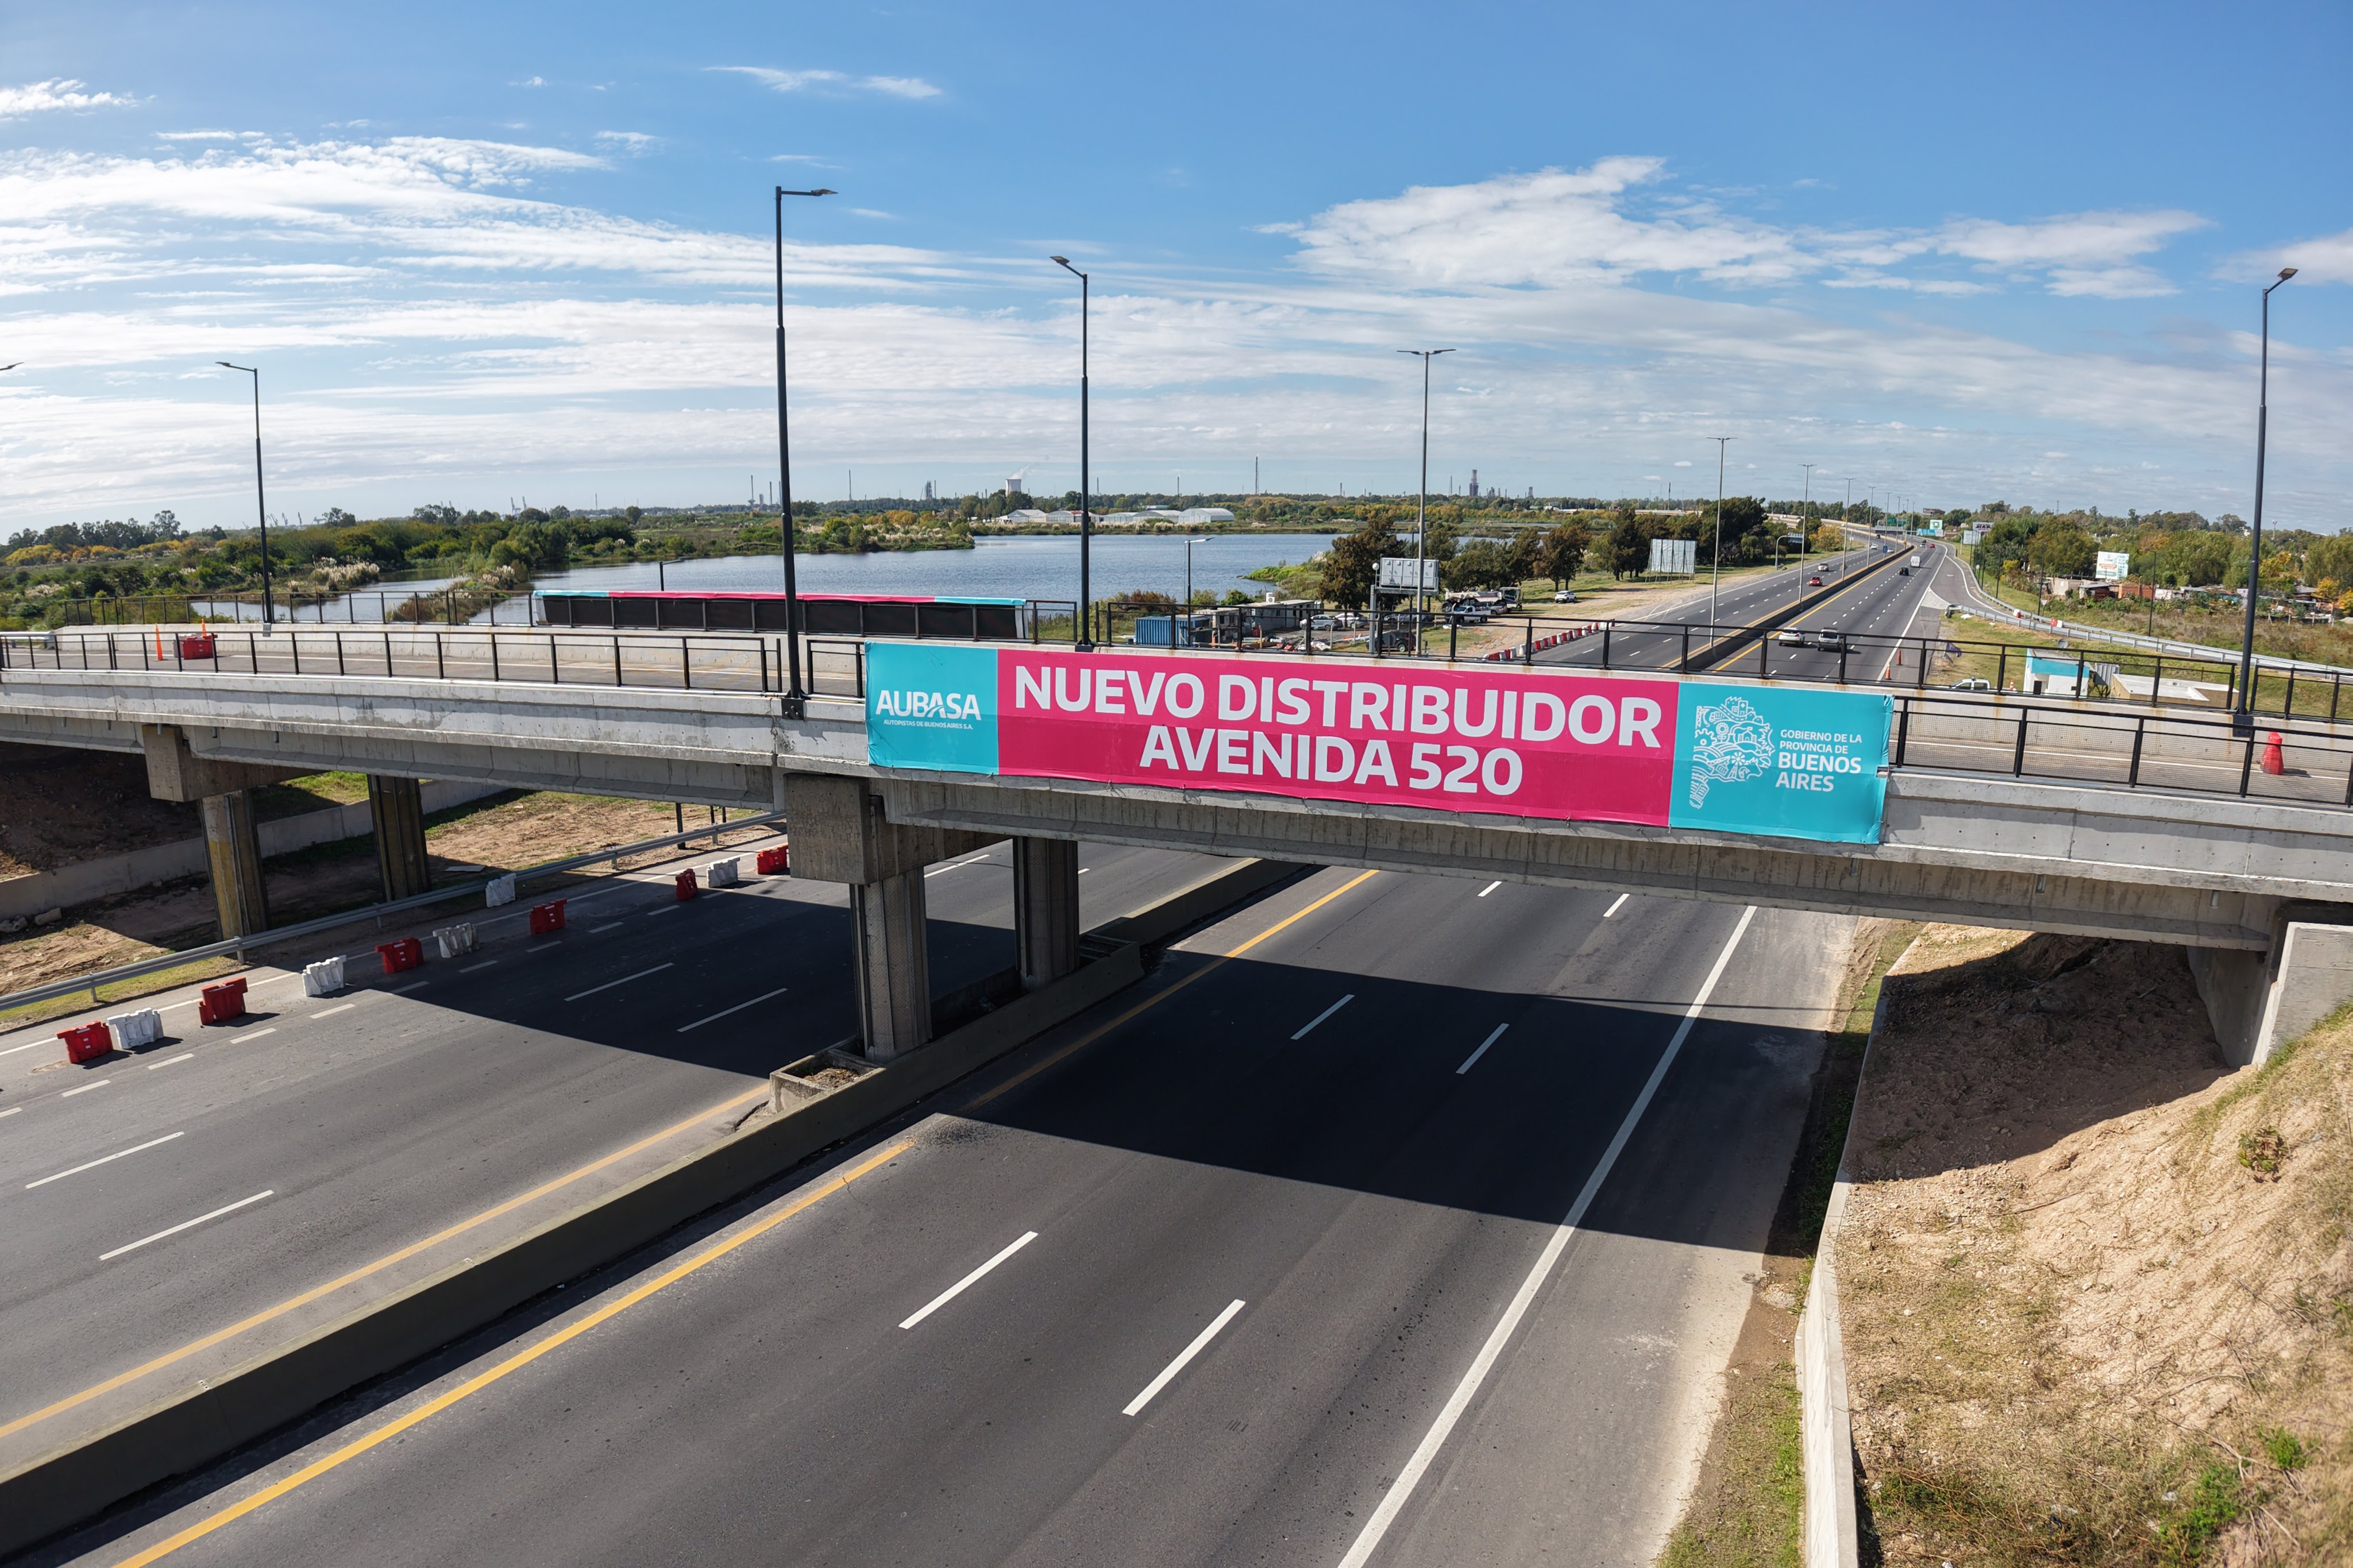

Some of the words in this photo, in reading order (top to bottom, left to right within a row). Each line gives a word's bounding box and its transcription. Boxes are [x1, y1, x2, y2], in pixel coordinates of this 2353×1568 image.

[875, 690, 981, 720] AUBASA
[1016, 666, 1205, 719] NUEVO
[1218, 674, 1661, 748] DISTRIBUIDOR
[1781, 729, 1831, 741] GOBIERNO
[1834, 733, 1847, 743] DE
[1849, 734, 1862, 743] LA
[1780, 741, 1833, 753] PROVINCIA
[1835, 746, 1848, 754] DE
[1139, 725, 1399, 786] AVENIDA
[1409, 742, 1523, 795] 520
[1778, 752, 1861, 774] BUENOS
[1775, 771, 1834, 792] AIRES
